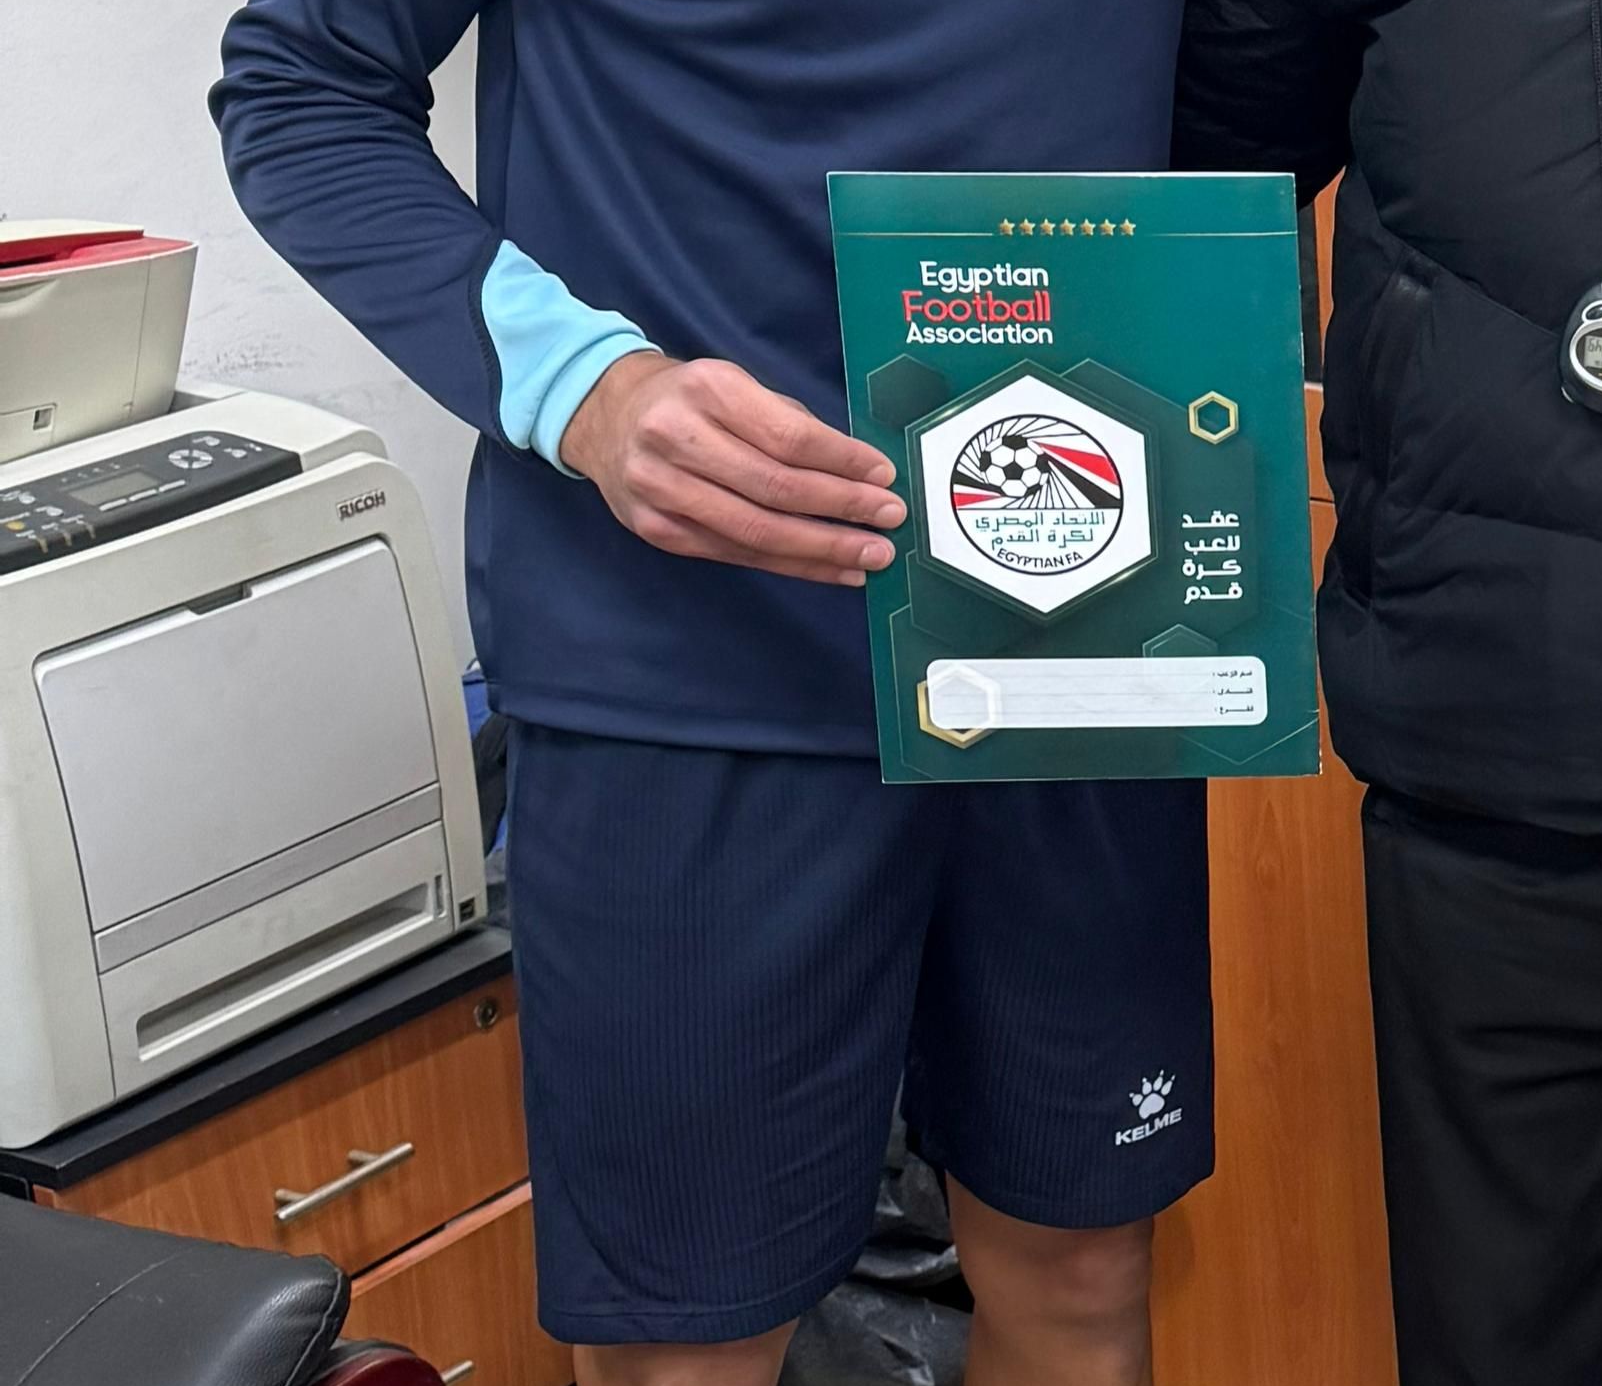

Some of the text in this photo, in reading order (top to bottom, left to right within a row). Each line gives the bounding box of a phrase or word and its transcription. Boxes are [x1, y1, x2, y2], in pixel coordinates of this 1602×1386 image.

[919, 260, 1050, 294] Egyptian
[901, 290, 1051, 323] Football
[906, 321, 1054, 345] Association
[338, 490, 386, 522] RICOH
[975, 511, 1105, 533] الاتحاد المصري
[1182, 510, 1239, 528] عقد
[991, 528, 1093, 551] لكرة القدم
[996, 547, 1084, 569] EGYPTIAN FA
[1182, 559, 1242, 581] كرة
[1183, 581, 1243, 605] قدم
[1115, 1108, 1182, 1146] KELME
